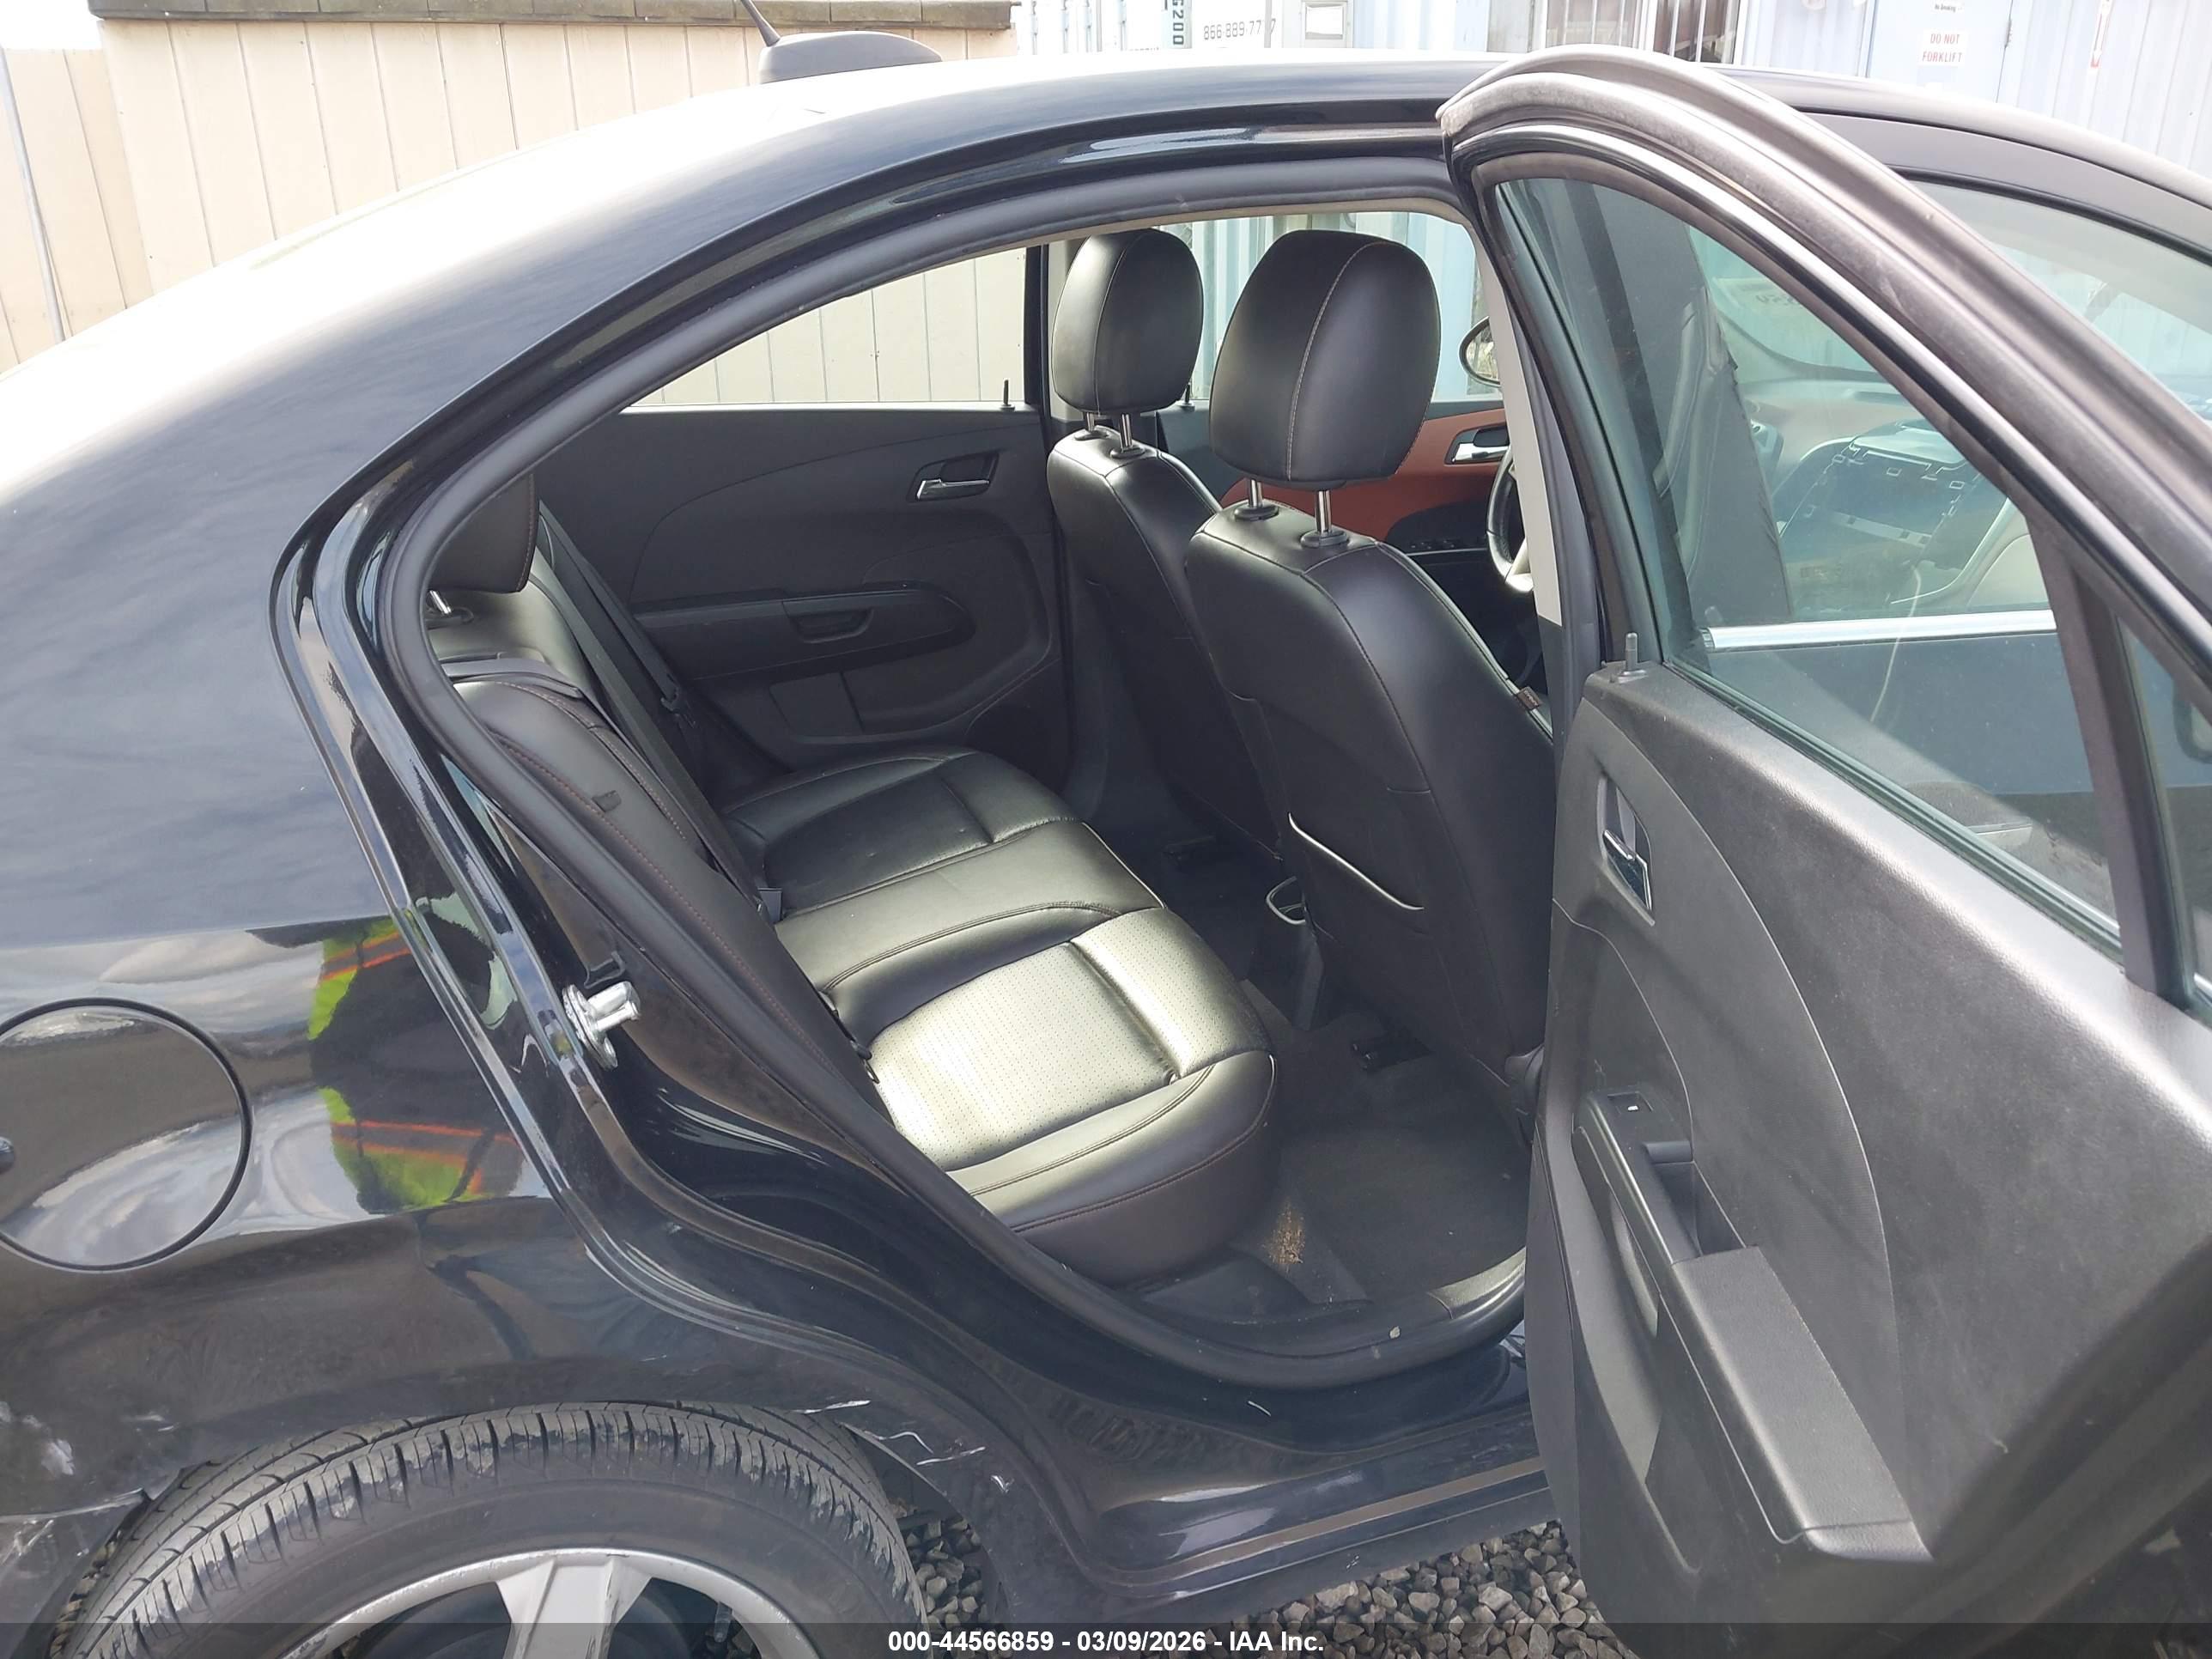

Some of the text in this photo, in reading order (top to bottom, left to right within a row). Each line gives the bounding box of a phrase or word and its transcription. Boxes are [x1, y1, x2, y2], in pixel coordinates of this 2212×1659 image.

[1930, 33, 1960, 44] DO NOT
[1923, 52, 1962, 62] FORKLIFT
